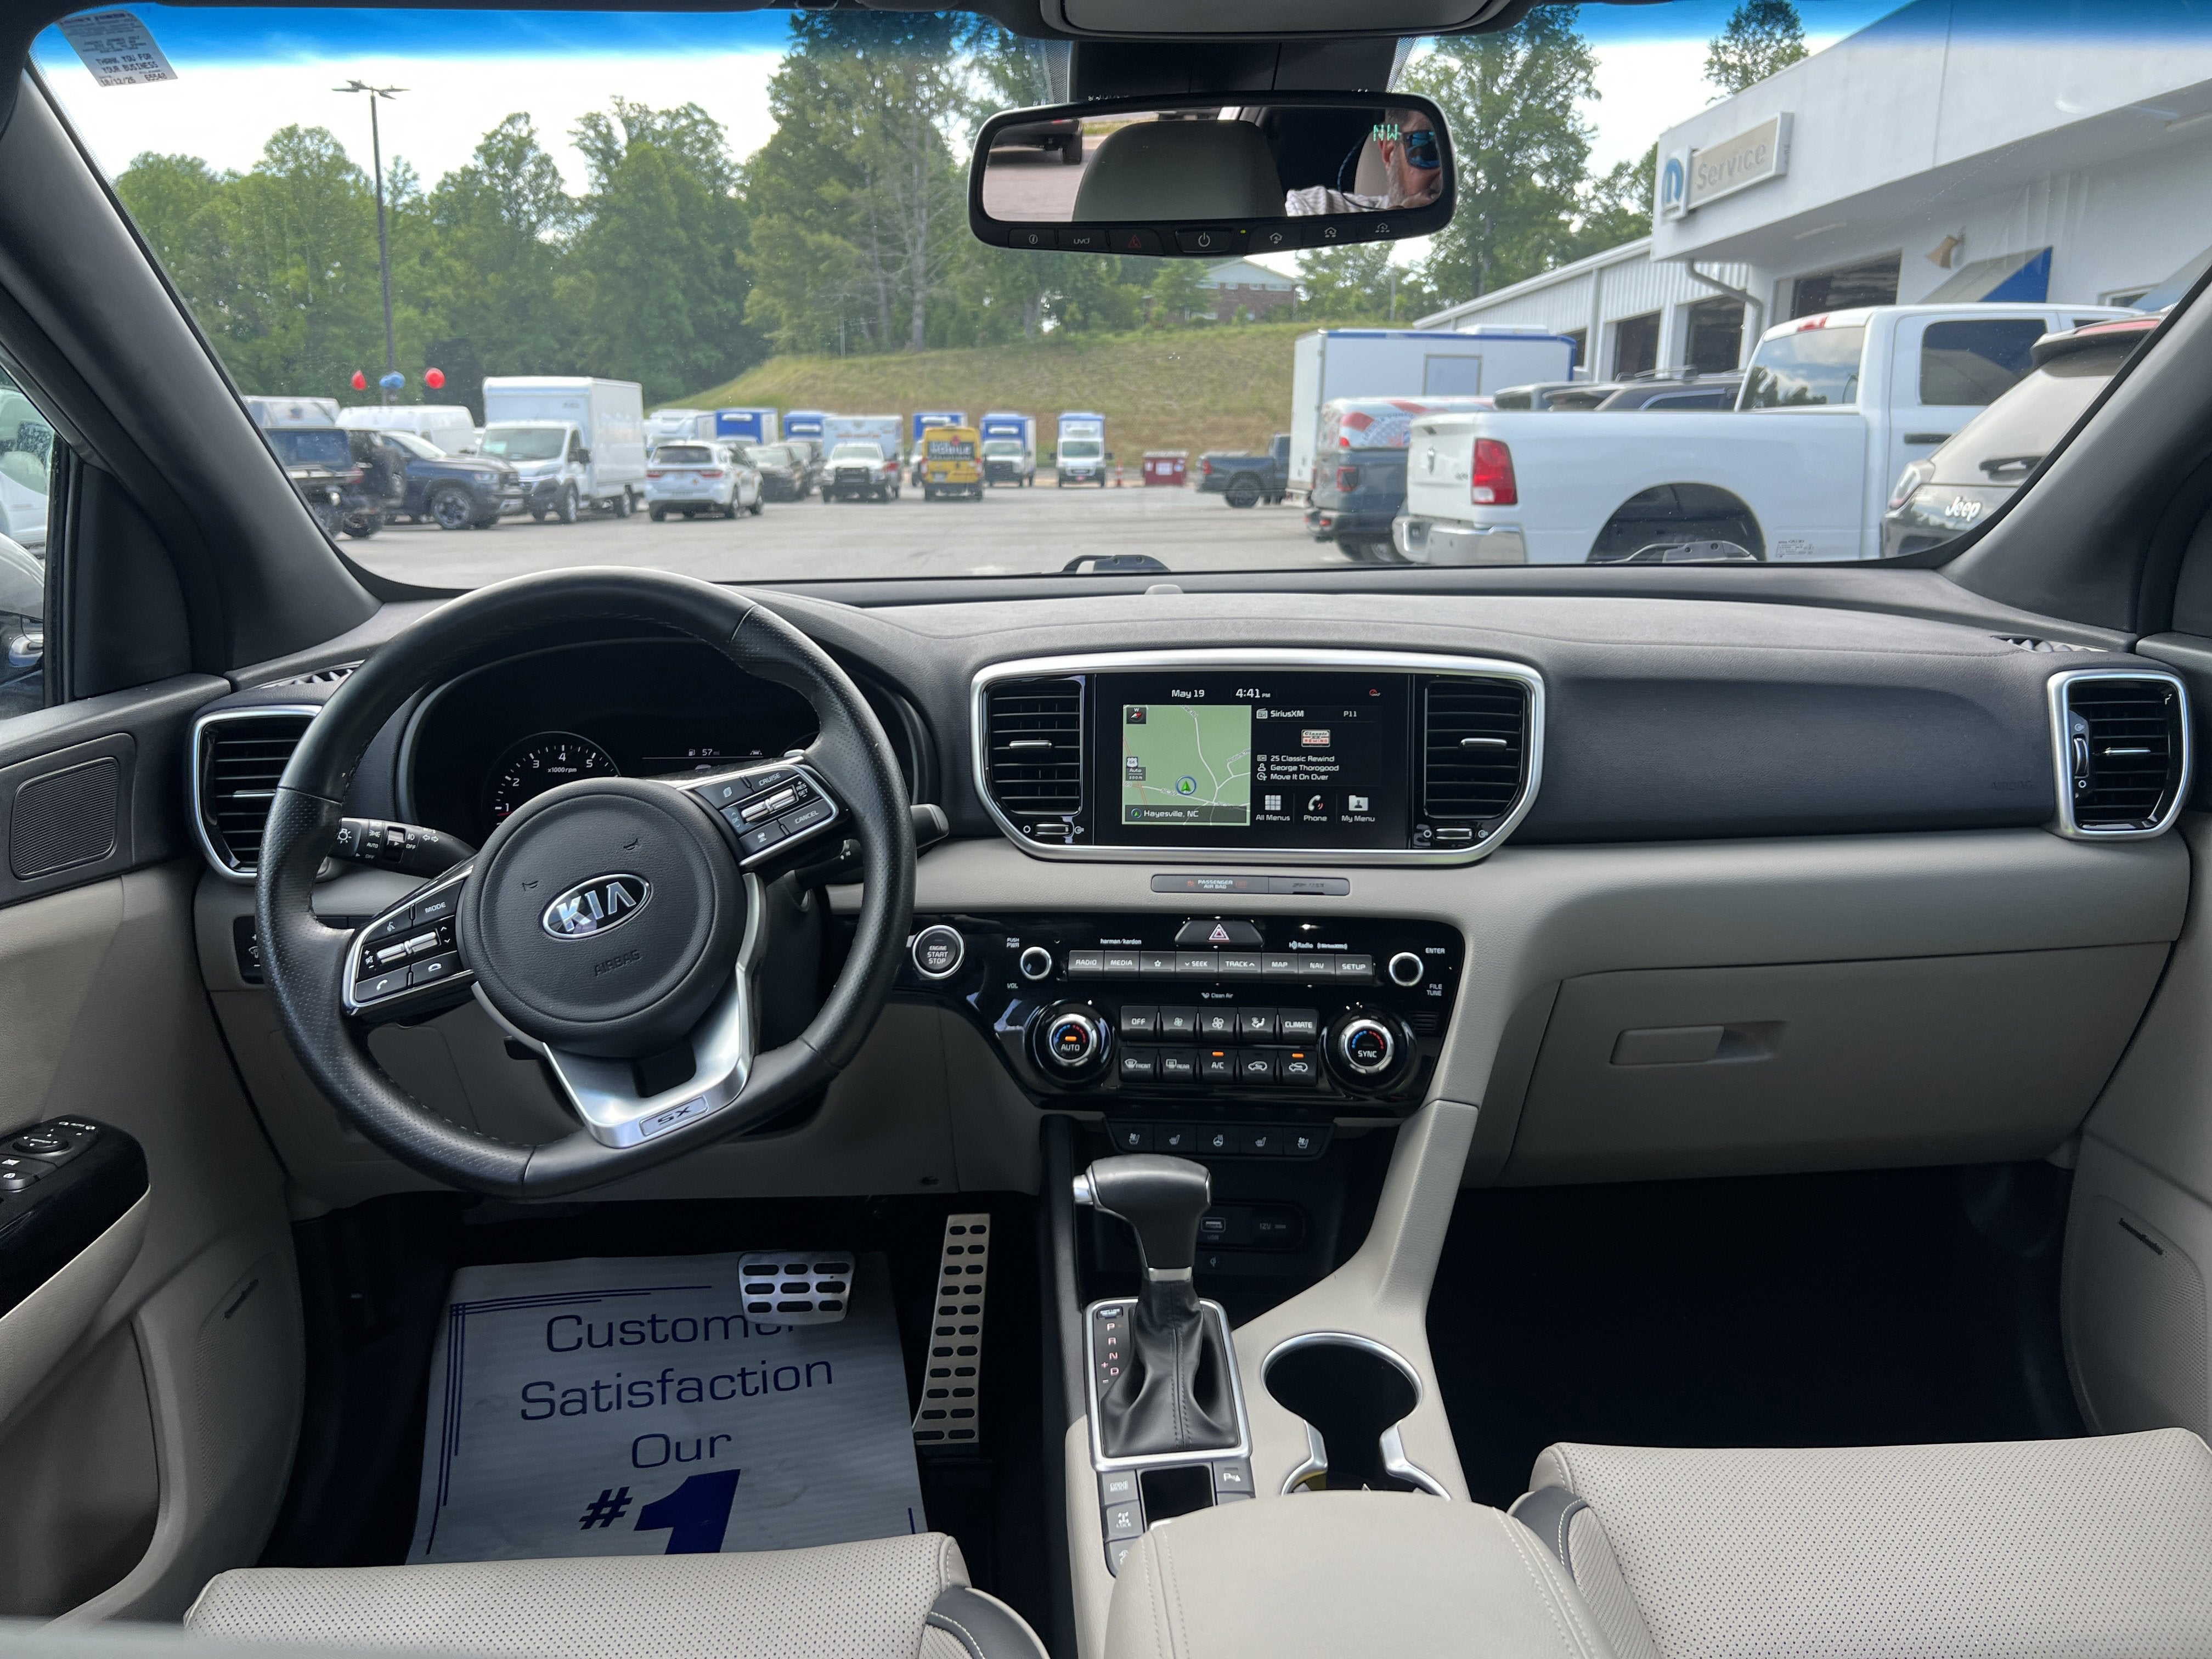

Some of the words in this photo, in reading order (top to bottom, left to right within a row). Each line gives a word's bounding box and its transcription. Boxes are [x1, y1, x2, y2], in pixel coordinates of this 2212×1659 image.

[122, 61, 159, 71] BUSINESS
[1373, 124, 1398, 142] NW
[1696, 143, 1767, 191] Service
[1945, 495, 1982, 522] Jeep
[1172, 690, 1191, 698] May
[1235, 689, 1261, 698] 4:41
[558, 753, 566, 762] 4
[586, 759, 593, 768] 5
[533, 760, 540, 768] 3
[513, 778, 520, 786] 2
[759, 772, 781, 786] CRUISE
[798, 788, 808, 797] SET
[505, 803, 509, 811] 1
[794, 810, 819, 824] CANCEL
[425, 901, 446, 913] MODE
[557, 881, 636, 932] KIA
[594, 949, 642, 977] AIRBAG
[1358, 1050, 1377, 1058] SYNC
[658, 1106, 691, 1125] SX
[546, 1313, 794, 1353] Custom
[1109, 1352, 1118, 1360] N
[1110, 1367, 1119, 1376] D
[521, 1359, 833, 1421] Satisfaction
[631, 1432, 732, 1469] Our
